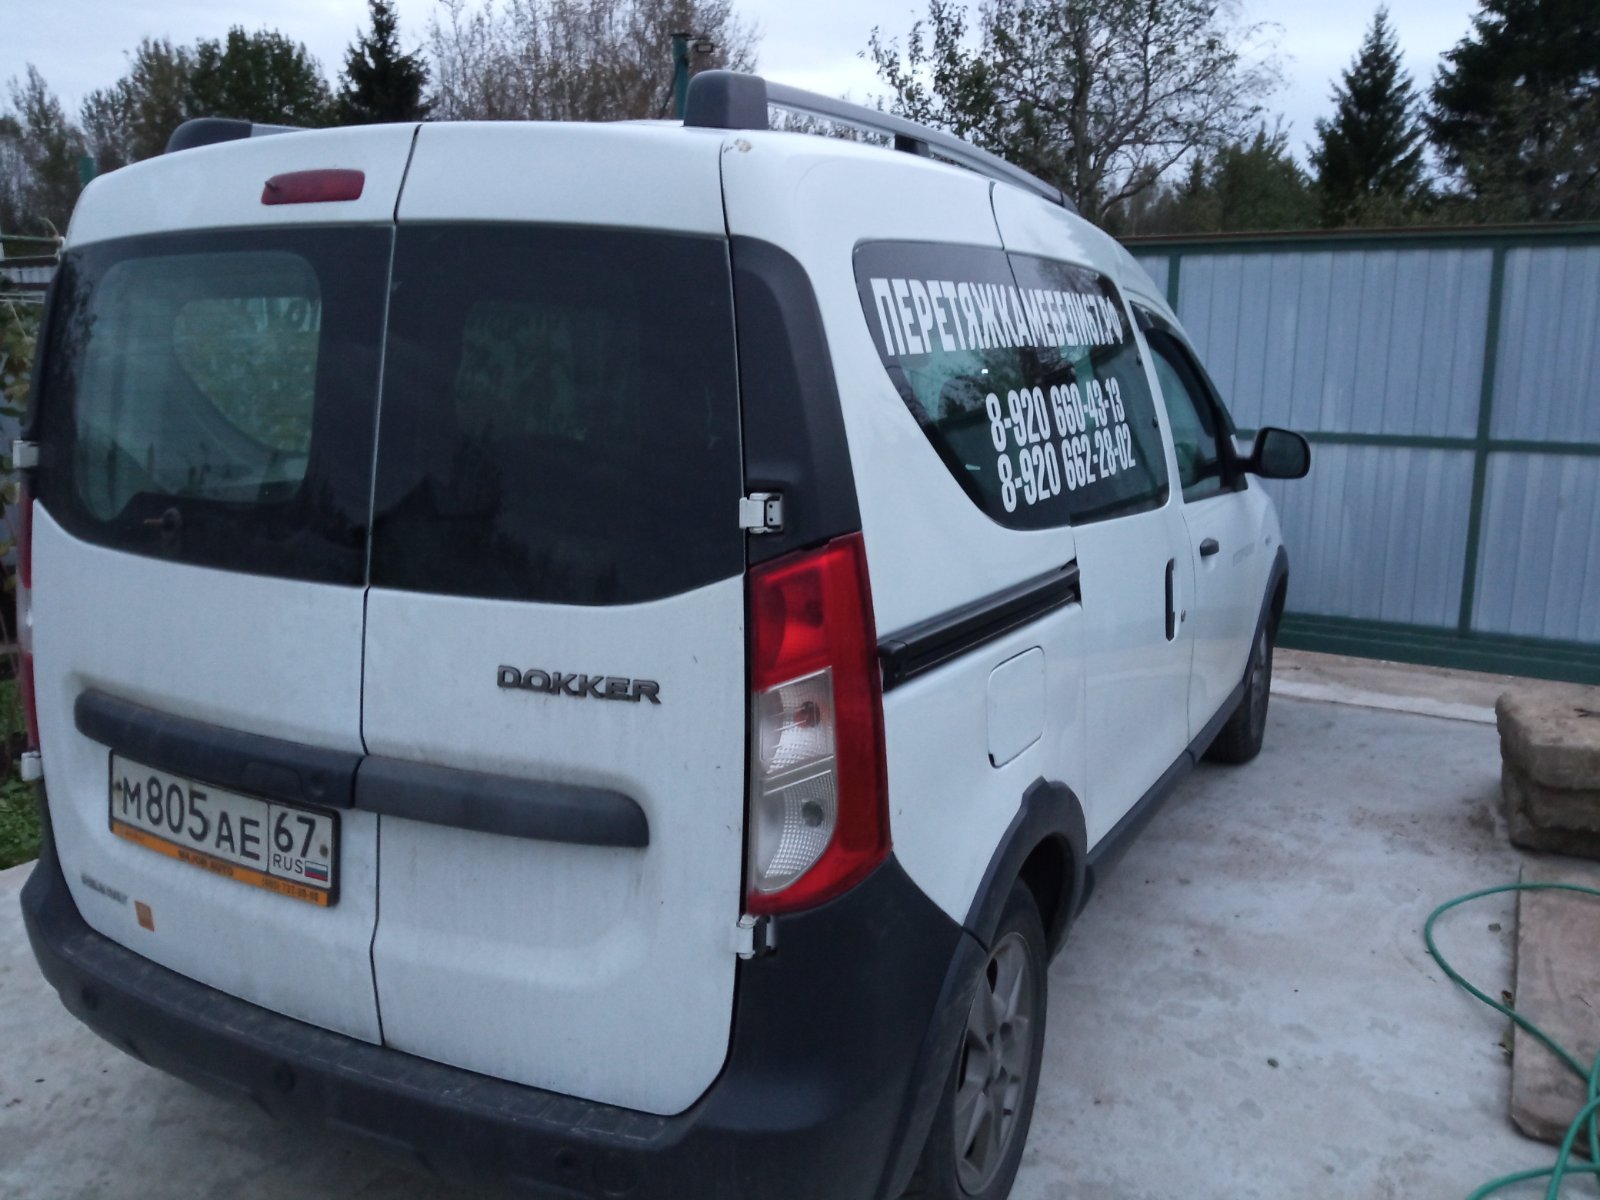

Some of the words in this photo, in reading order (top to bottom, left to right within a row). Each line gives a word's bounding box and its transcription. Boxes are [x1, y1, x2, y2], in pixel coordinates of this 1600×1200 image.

[870, 278, 1124, 356] ПЕРЕТЯЖКАМЕБЕЛИ67.РФ
[985, 386, 1051, 452] 8-920
[1050, 377, 1126, 437] 660-43-13
[997, 442, 1061, 513] 8-920
[1061, 422, 1136, 491] 662-28-02
[497, 665, 662, 704] DOKKER
[272, 853, 303, 874] RUS
[273, 812, 316, 858] 67
